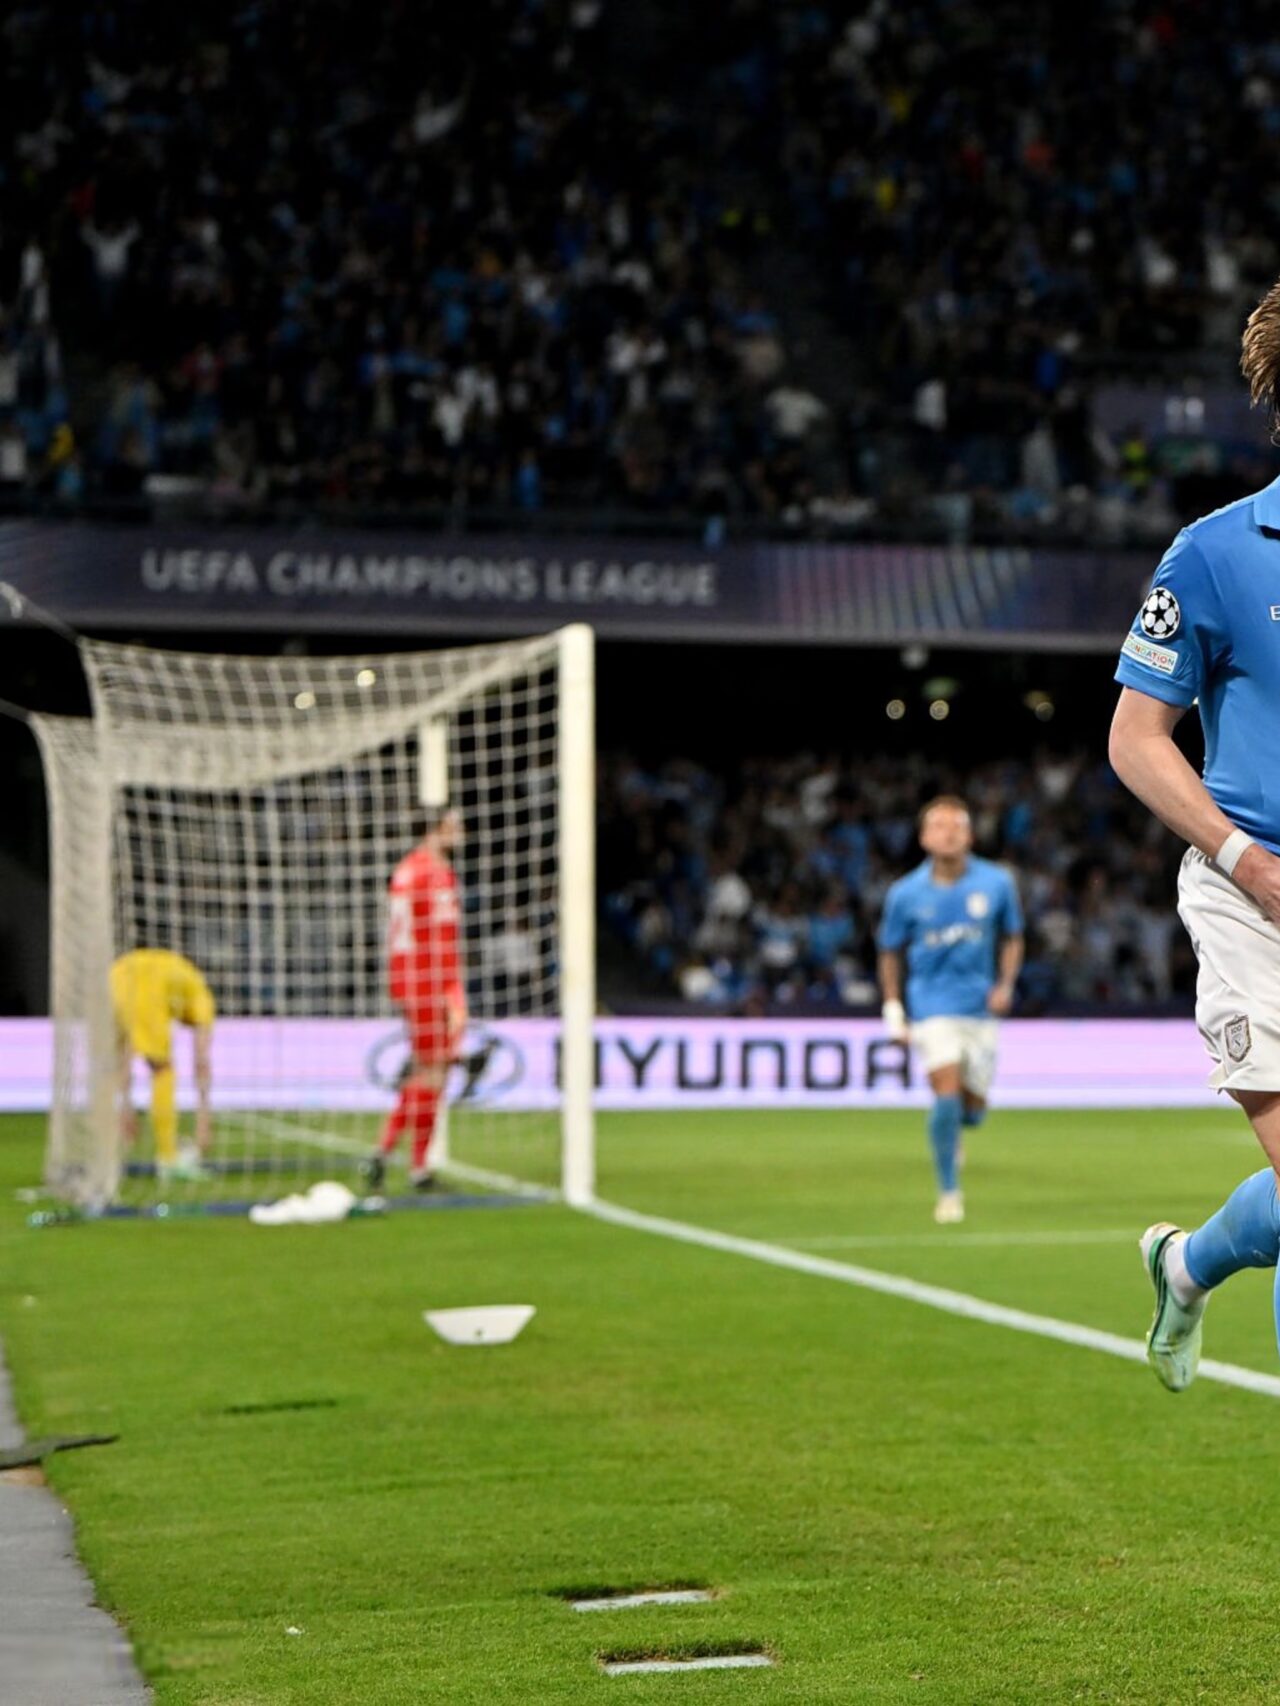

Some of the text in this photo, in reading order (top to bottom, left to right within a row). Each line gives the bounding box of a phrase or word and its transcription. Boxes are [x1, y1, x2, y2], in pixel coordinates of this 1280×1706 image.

[141, 550, 717, 605] UEFA CHAMPIONS LEAGUE
